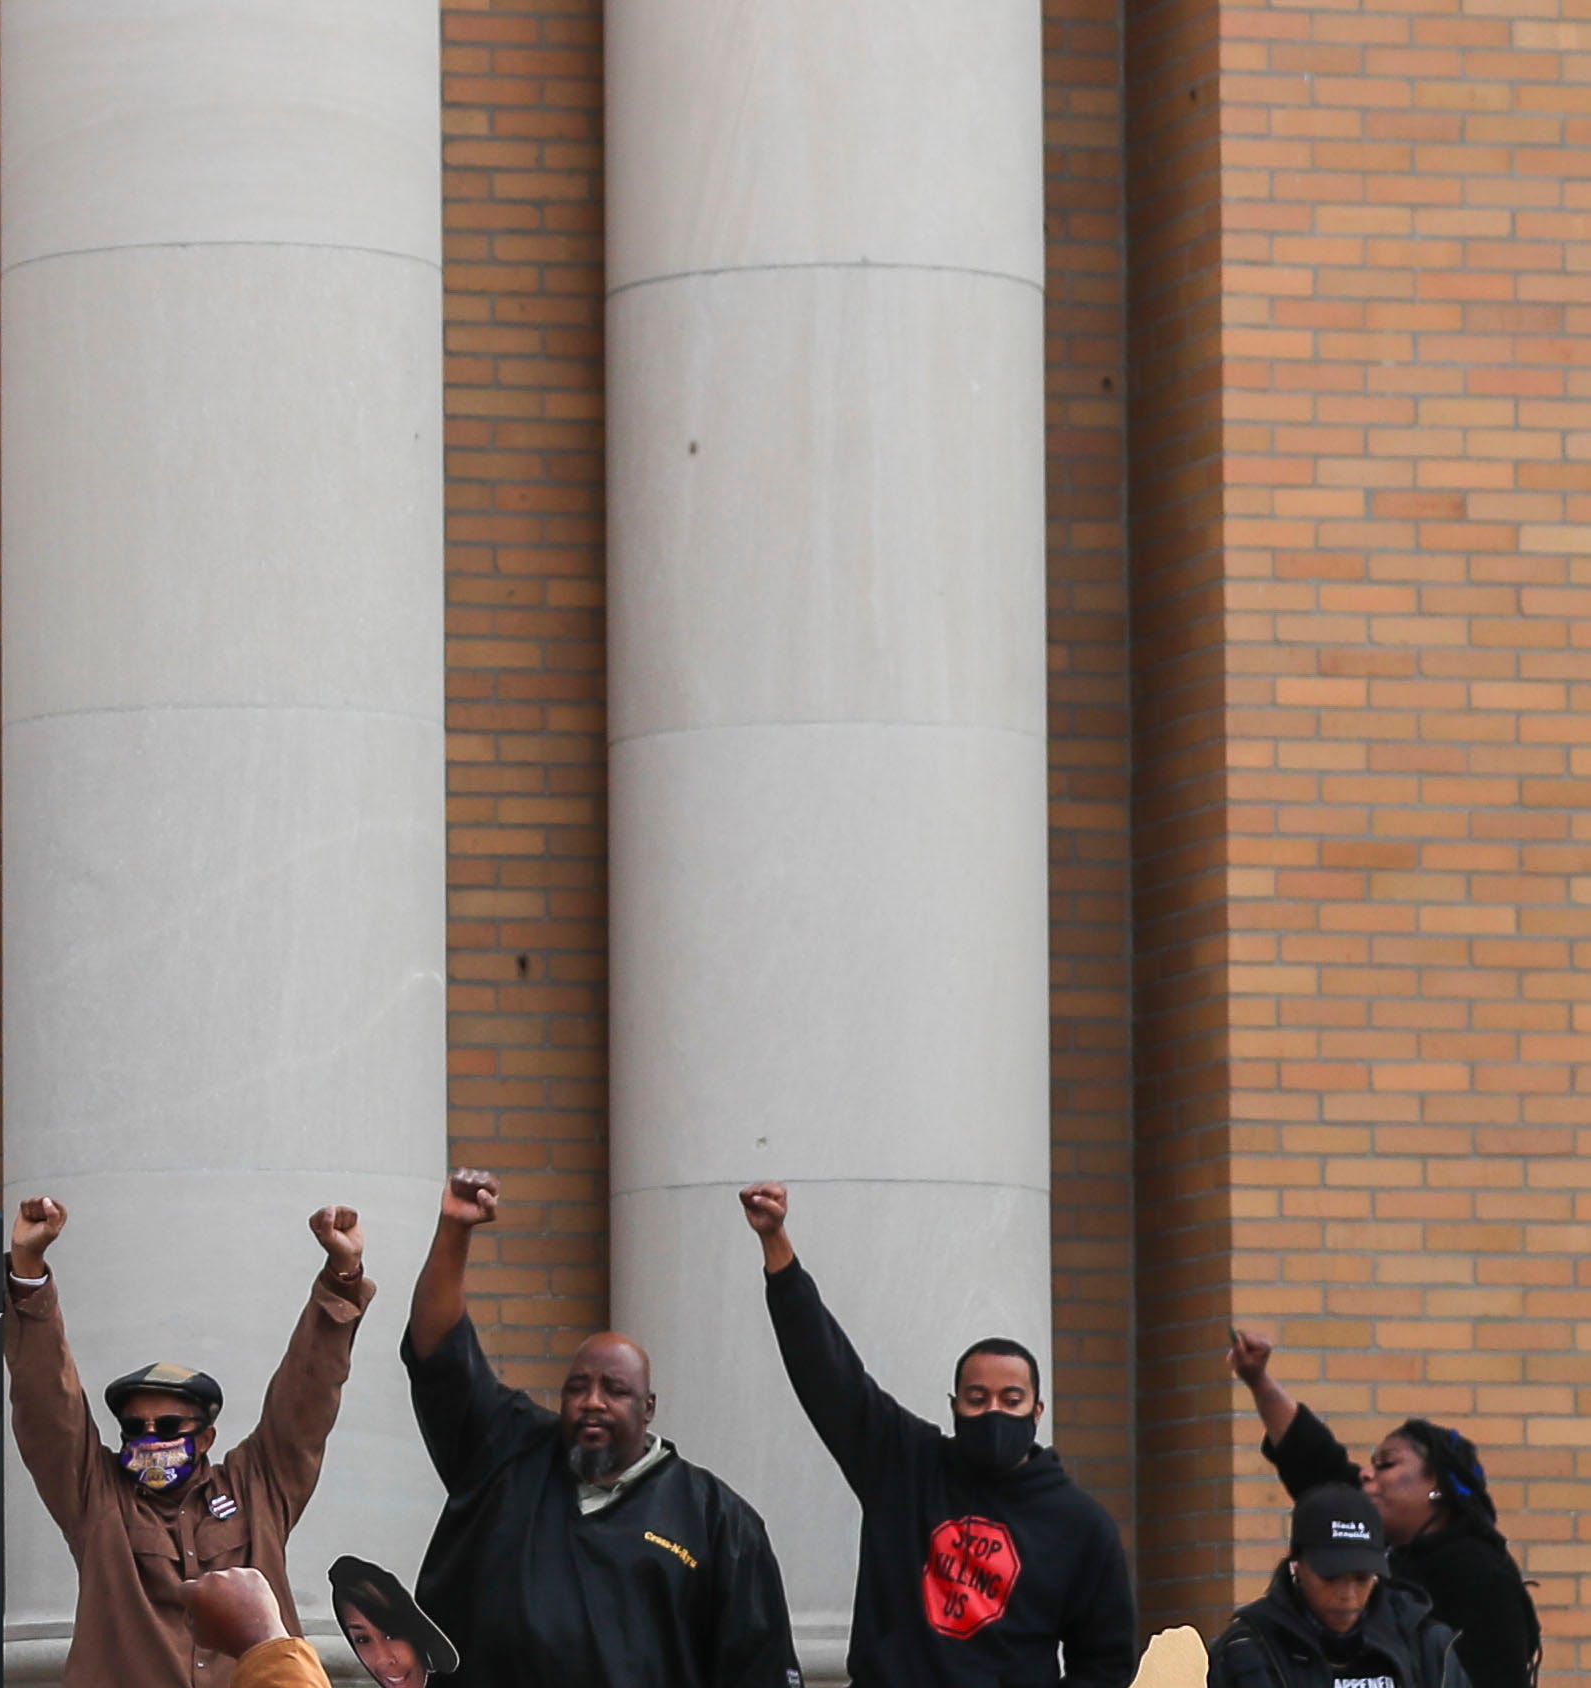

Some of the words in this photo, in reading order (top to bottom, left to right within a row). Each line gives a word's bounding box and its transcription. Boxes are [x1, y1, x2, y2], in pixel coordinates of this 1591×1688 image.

[952, 1527, 1003, 1561] STOP
[935, 1551, 1004, 1600] KILLING
[944, 1589, 969, 1619] US
